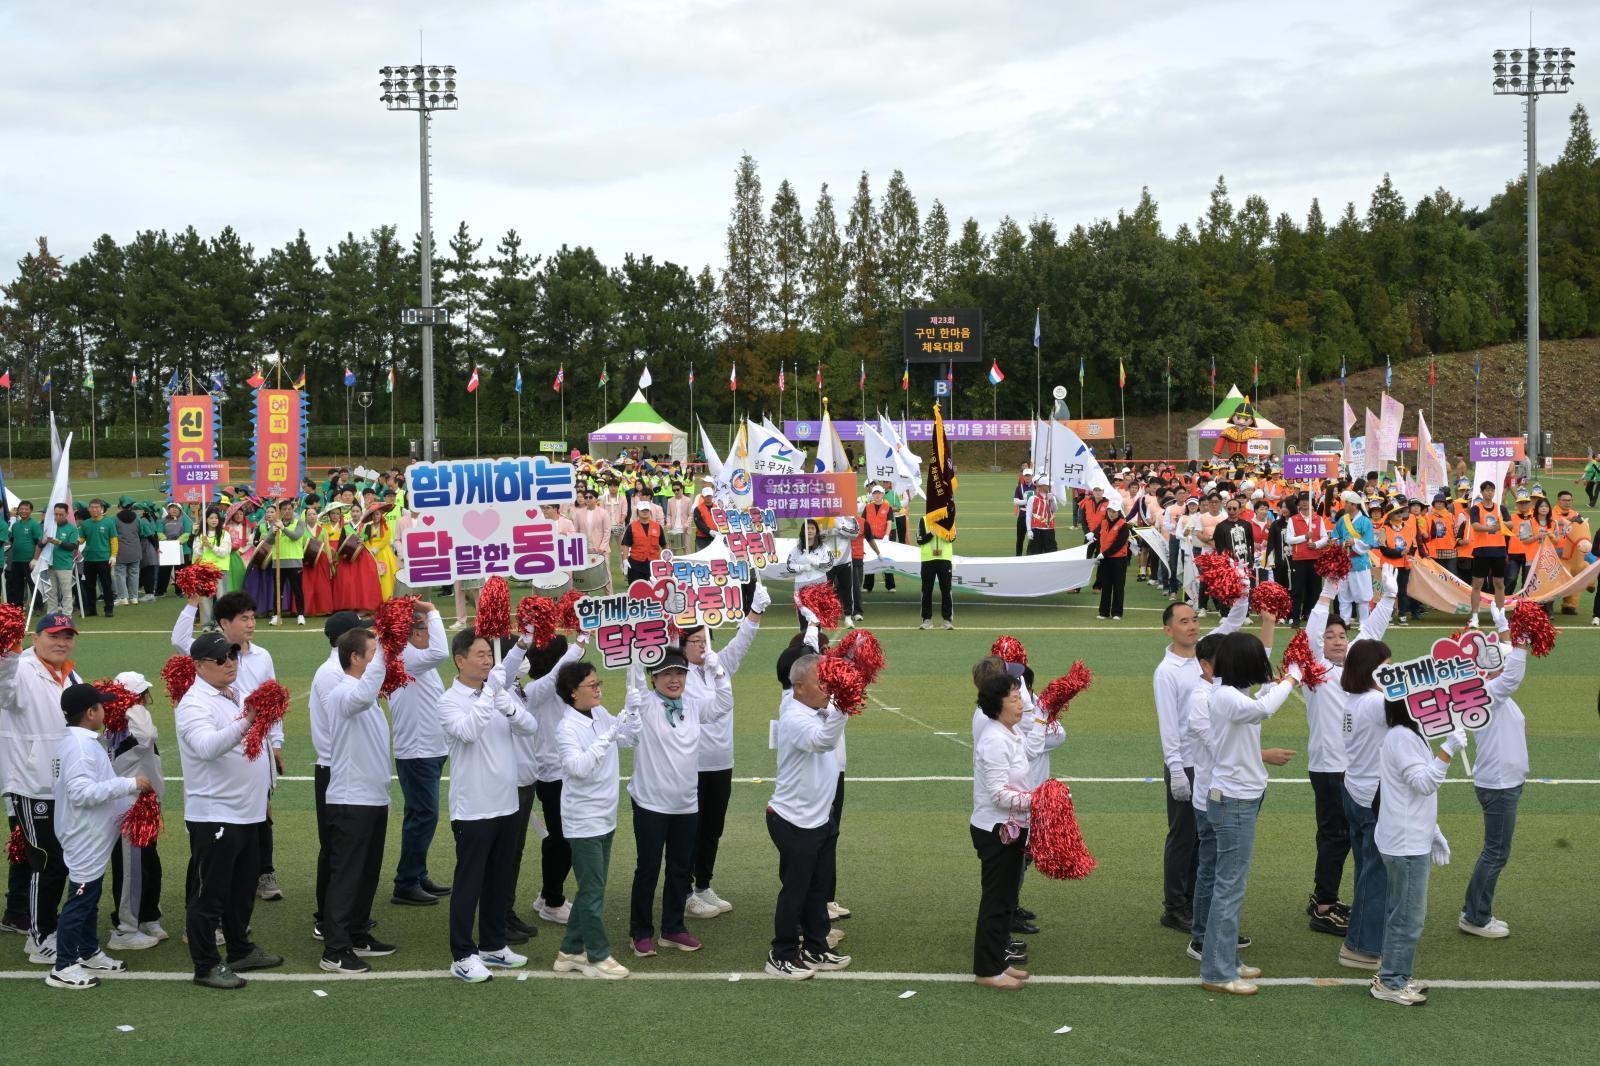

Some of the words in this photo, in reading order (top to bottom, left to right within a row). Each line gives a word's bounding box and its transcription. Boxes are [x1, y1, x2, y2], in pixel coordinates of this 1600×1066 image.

[401, 308, 448, 324] 10:17
[930, 316, 955, 325] 제23회
[915, 327, 936, 339] 구민
[940, 327, 971, 339] 한마음
[922, 341, 964, 353] 체육대회
[936, 381, 947, 395] B
[1480, 447, 1514, 457] 신정3동
[767, 461, 794, 475] 무거동
[876, 465, 894, 476] 남구
[1064, 463, 1084, 474] 남구
[1294, 464, 1327, 474] 신정1동
[186, 470, 219, 481] 신정2동
[410, 459, 573, 508] 함께하는
[766, 498, 843, 510] 한마음체육대회
[577, 595, 662, 627] 함께하는
[597, 620, 669, 668] 달동
[1377, 656, 1477, 699] 함께하는
[1407, 678, 1492, 738] 달동
